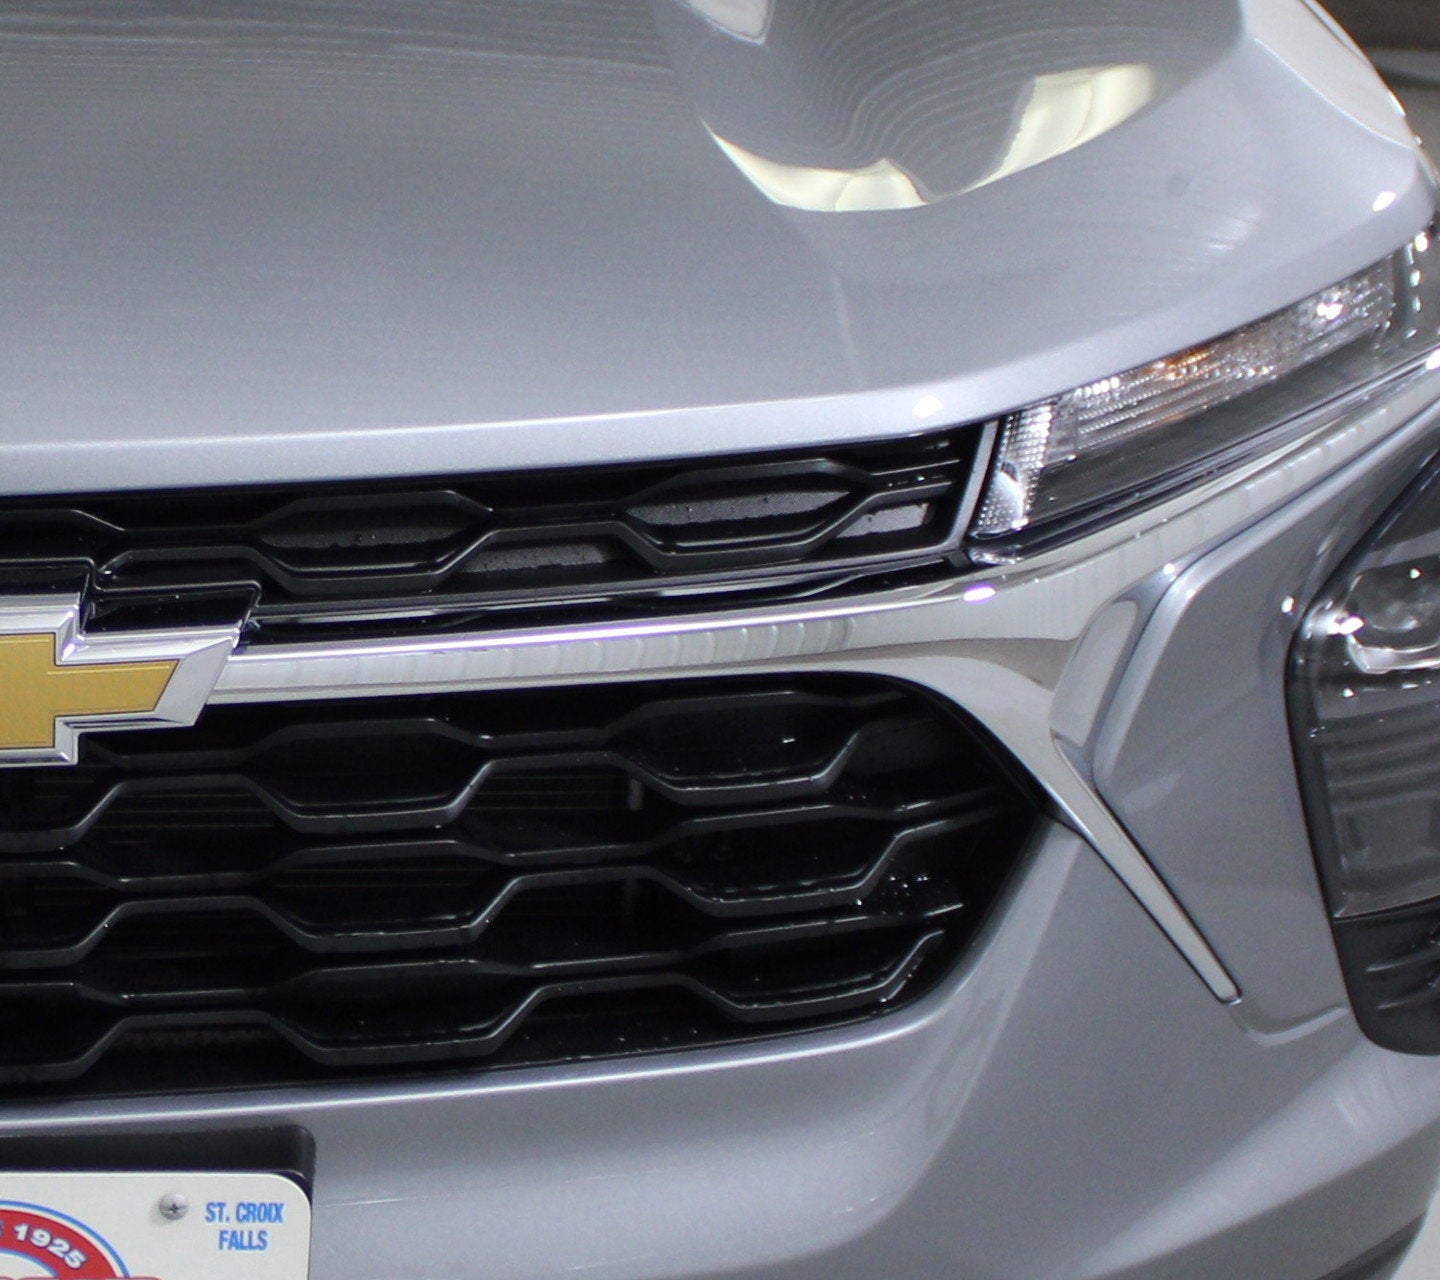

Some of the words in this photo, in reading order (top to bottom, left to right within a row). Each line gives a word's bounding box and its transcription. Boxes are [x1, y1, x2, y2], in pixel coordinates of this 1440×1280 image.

[205, 1202, 231, 1224] ST.
[235, 1202, 284, 1224] CROIX
[13, 1223, 87, 1270] 1925
[218, 1230, 268, 1251] FALLS
